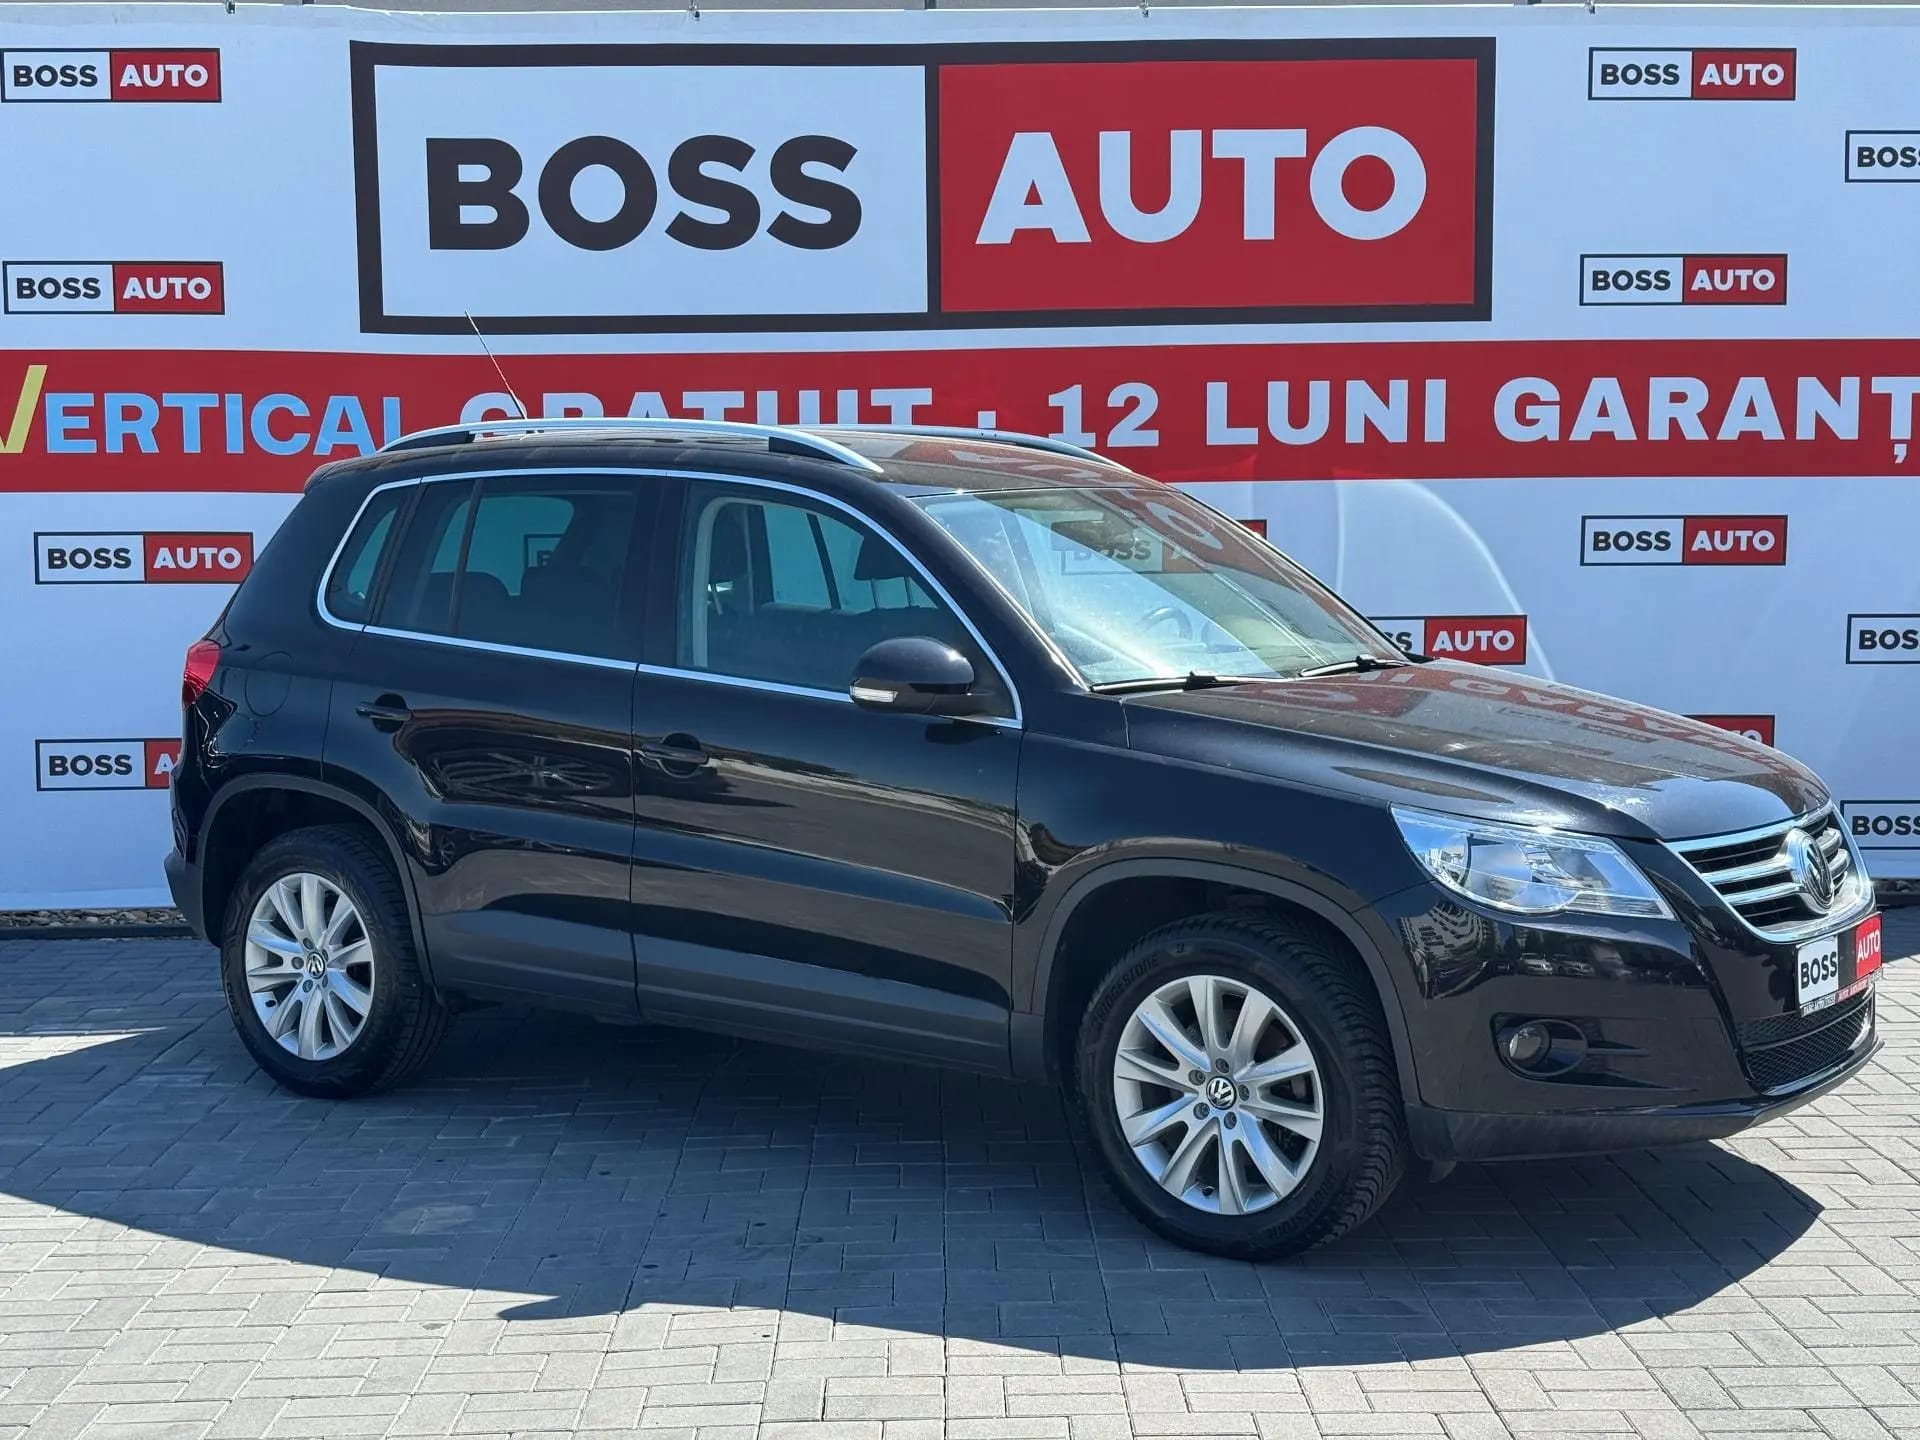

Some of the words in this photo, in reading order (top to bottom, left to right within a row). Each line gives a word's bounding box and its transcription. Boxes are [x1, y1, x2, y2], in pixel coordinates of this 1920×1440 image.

[15, 66, 98, 88] BOSS
[120, 65, 209, 88] AUTO
[1601, 65, 1680, 86] BOSS
[1701, 64, 1785, 86] AUTO
[1858, 147, 1920, 168] BOS
[427, 136, 862, 252] BOSS
[976, 127, 1427, 245] AUTO
[17, 278, 101, 300] BOSS
[123, 278, 212, 300] AUTO
[1592, 271, 1671, 291] BOSS
[1692, 270, 1776, 291] AUTO
[1048, 383, 1160, 448] 12
[1206, 380, 1447, 446] LUNI
[1593, 532, 1672, 552] BOSS
[1692, 531, 1776, 552] AUTO
[48, 548, 132, 570] BOSS
[154, 548, 242, 570] AUTO
[1432, 630, 1515, 652] AUTO
[1859, 630, 1920, 650] BOS
[49, 756, 133, 777] BOSS
[1800, 951, 1838, 989] BOSS
[1856, 929, 1880, 962] AUTO
